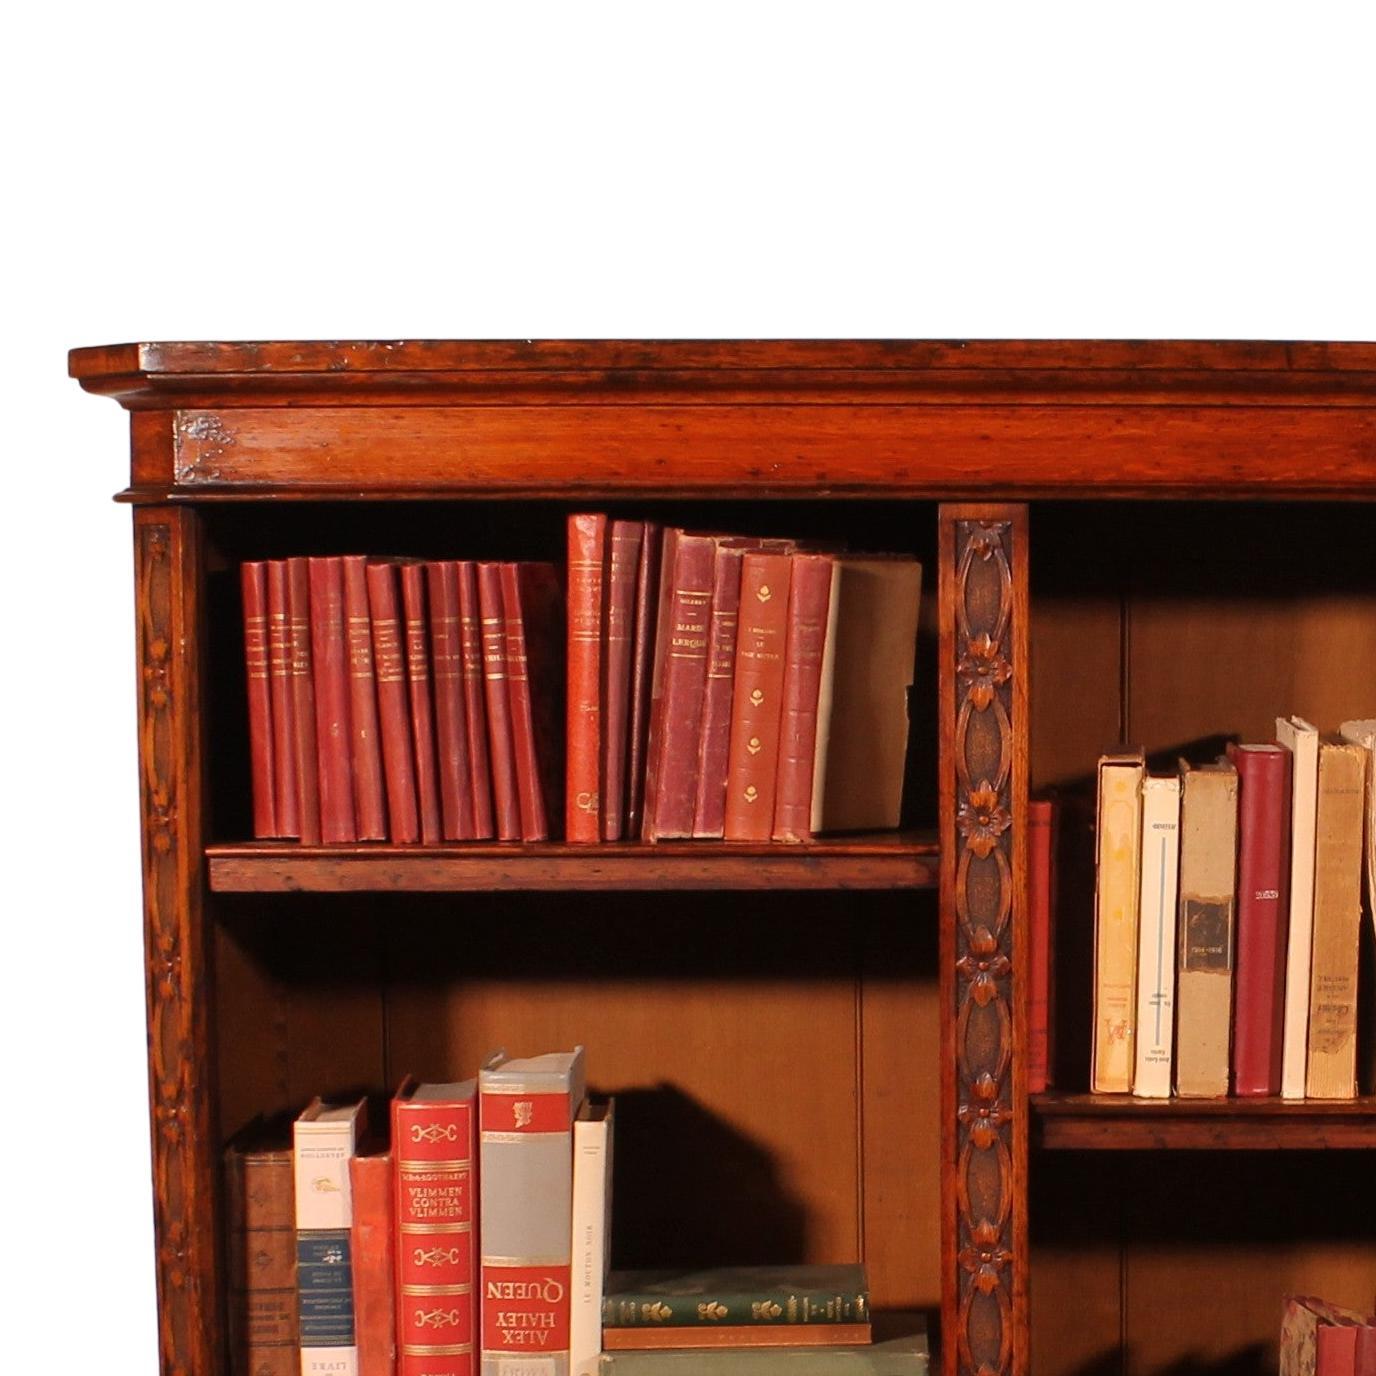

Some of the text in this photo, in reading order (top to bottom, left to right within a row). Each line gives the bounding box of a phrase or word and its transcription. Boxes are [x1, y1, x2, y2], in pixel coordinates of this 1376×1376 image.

[408, 1186, 463, 1198] VLIMMEN
[412, 1197, 460, 1208] CONTRA
[409, 1207, 463, 1218] VLIMMEN
[486, 1277, 565, 1303] QUEEN
[495, 1311, 557, 1327] HALEY
[501, 1328, 550, 1346] ALEX
